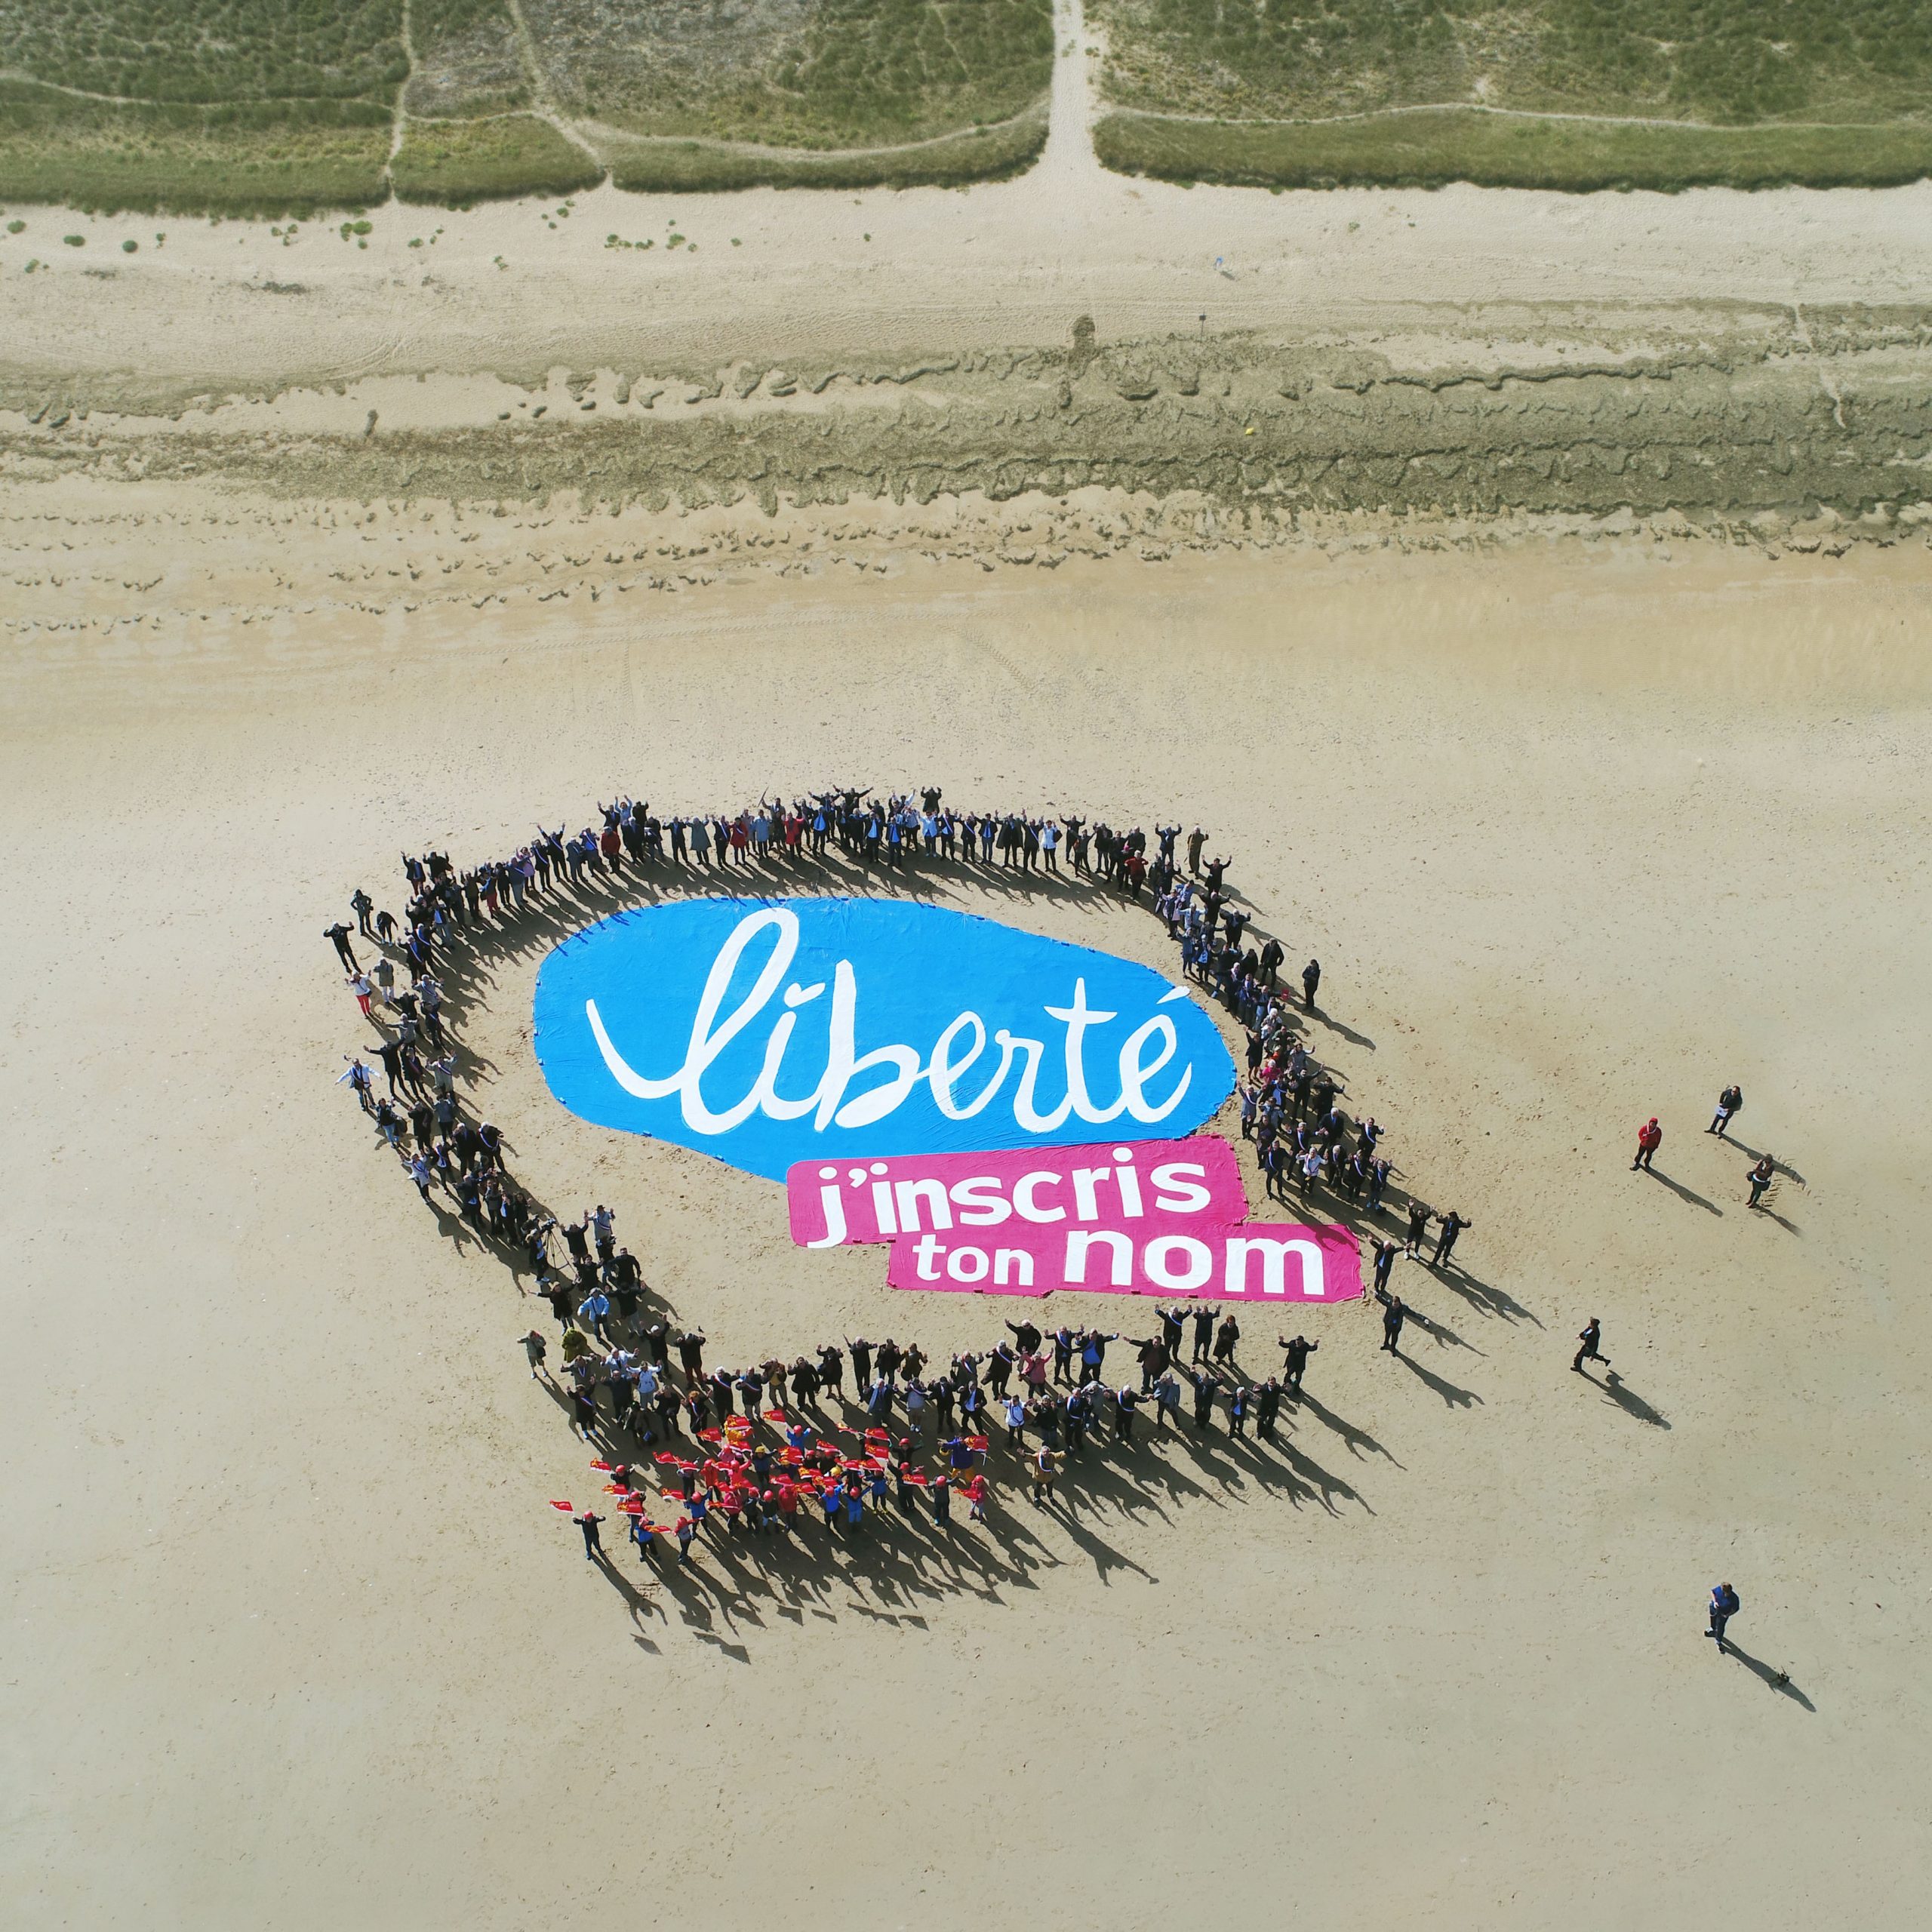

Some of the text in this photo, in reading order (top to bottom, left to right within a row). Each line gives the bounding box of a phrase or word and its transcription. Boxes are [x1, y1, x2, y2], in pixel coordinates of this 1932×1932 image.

[586, 907, 1192, 1135] liberté
[806, 1147, 1212, 1250] j'inscris
[912, 1229, 1325, 1296] ton nom
